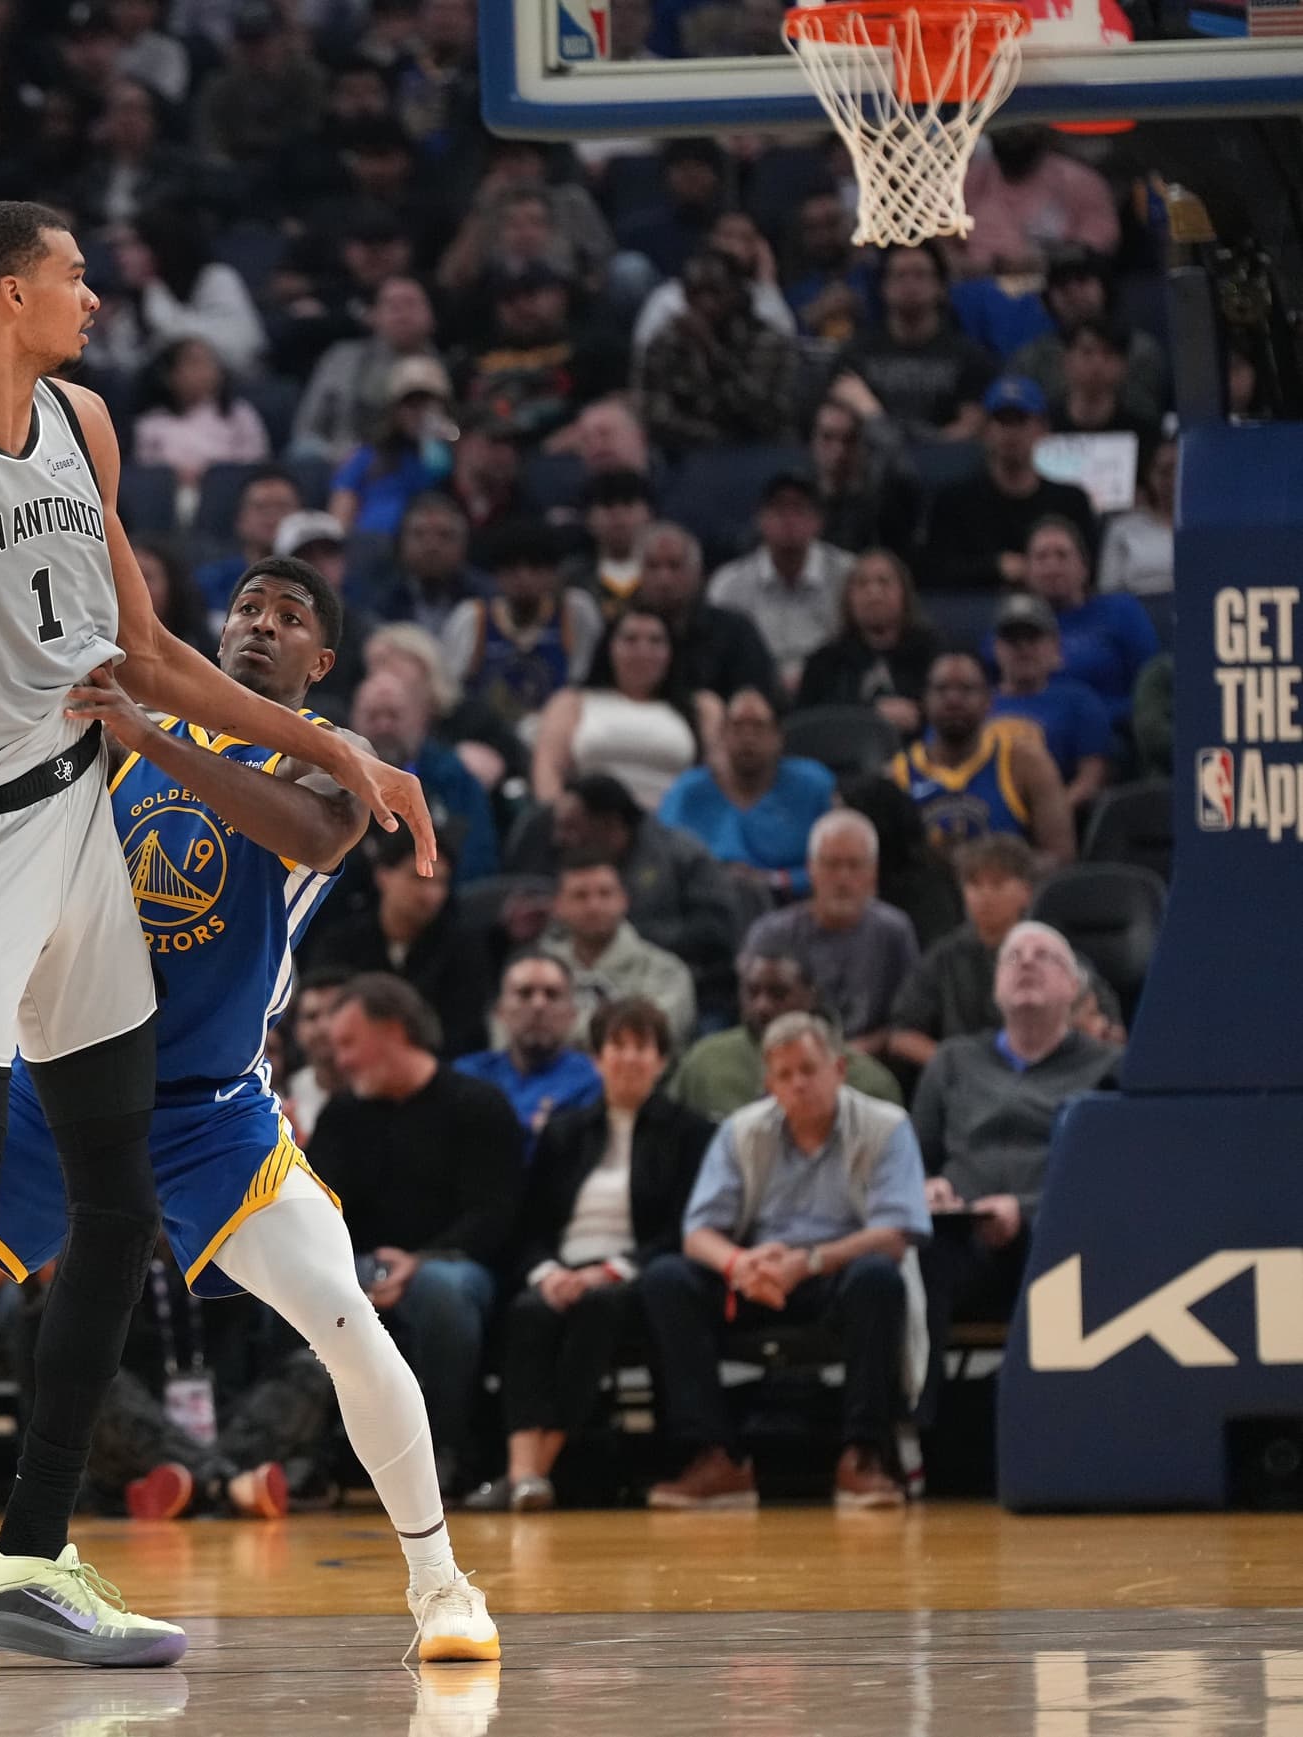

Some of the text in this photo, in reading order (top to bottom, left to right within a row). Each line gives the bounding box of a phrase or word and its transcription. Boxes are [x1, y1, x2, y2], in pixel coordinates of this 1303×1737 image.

[52, 457, 75, 472] LEDGER
[12, 496, 105, 546] ANTONIO
[30, 565, 65, 644] 1
[1213, 586, 1301, 665] GET
[1213, 667, 1302, 743] THE
[1238, 750, 1303, 843] Ap
[183, 838, 215, 873] 19
[143, 915, 226, 953] RIORS
